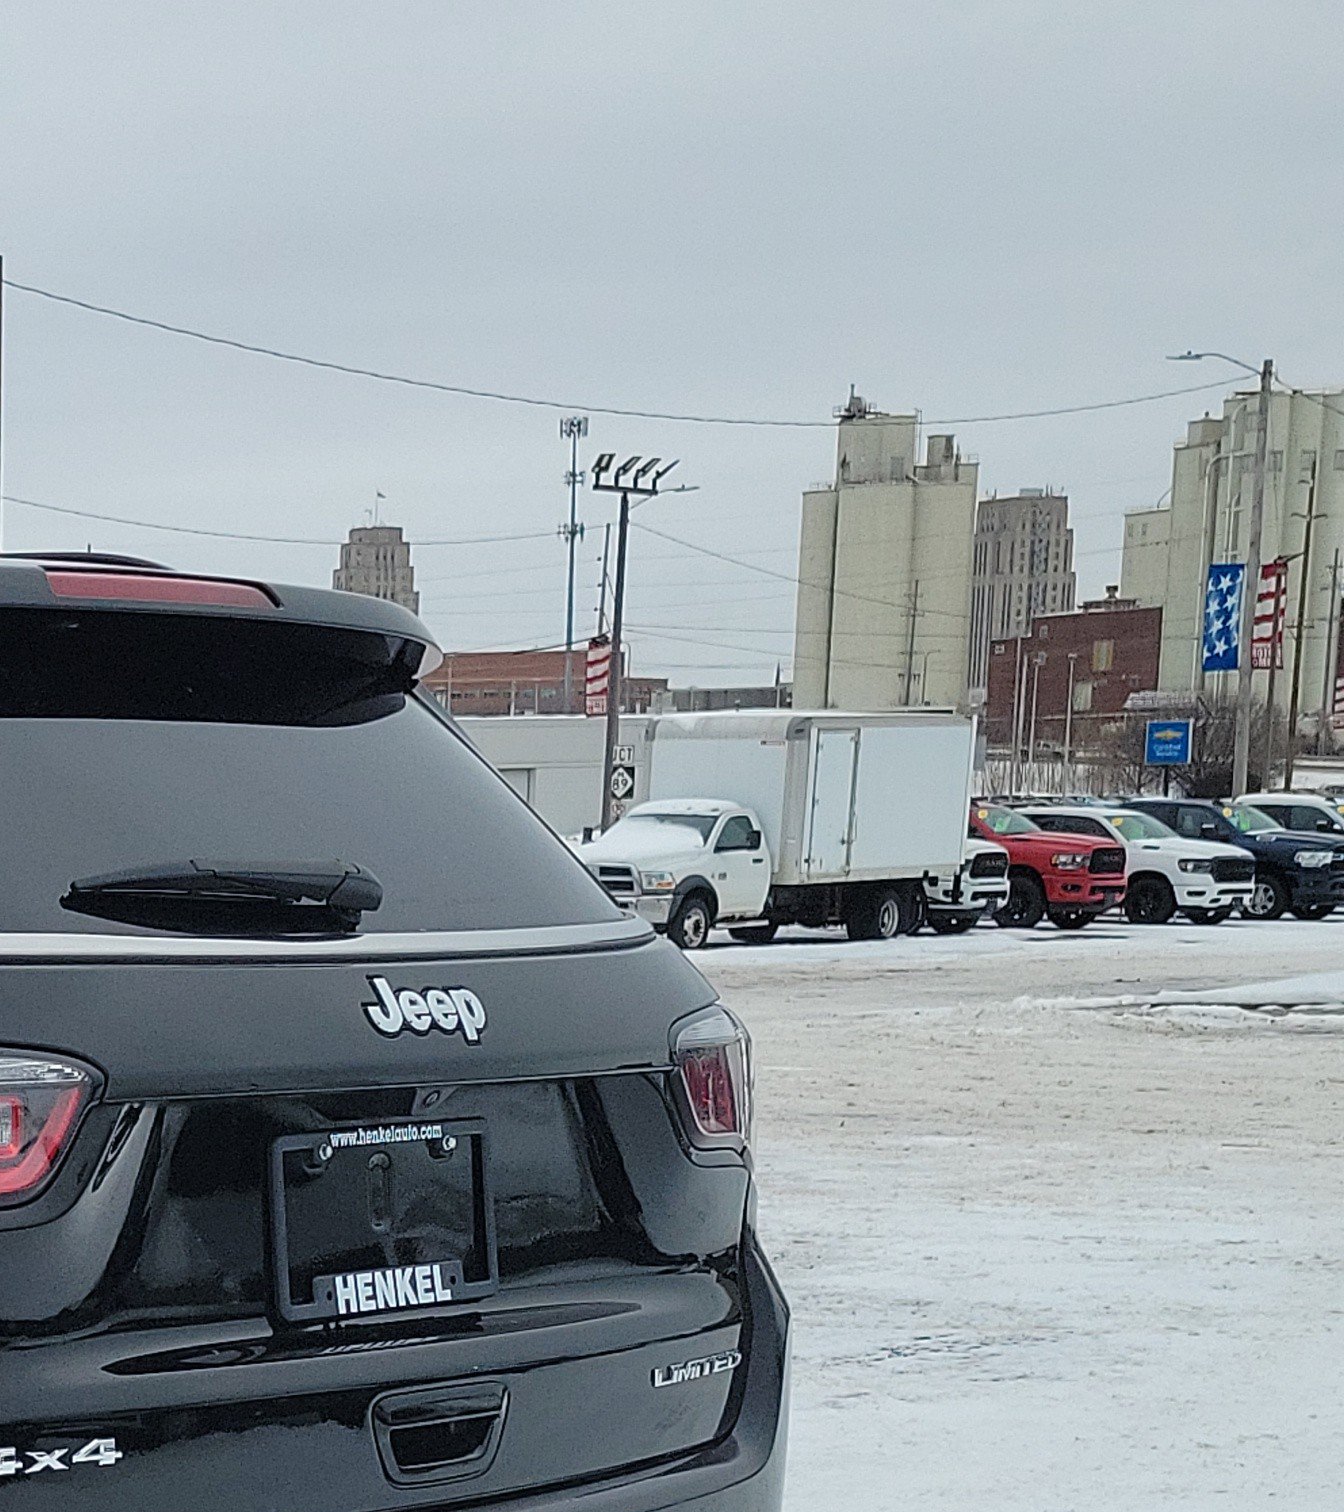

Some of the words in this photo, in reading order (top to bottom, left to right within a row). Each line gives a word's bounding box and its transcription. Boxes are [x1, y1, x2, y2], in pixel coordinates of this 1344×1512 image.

[613, 747, 632, 762] JCT
[613, 778, 628, 790] 89
[362, 975, 487, 1046] Jeep
[330, 1124, 443, 1148] www.henkelauto.com
[335, 1264, 452, 1315] HENKEL
[652, 1350, 742, 1388] LIMITED
